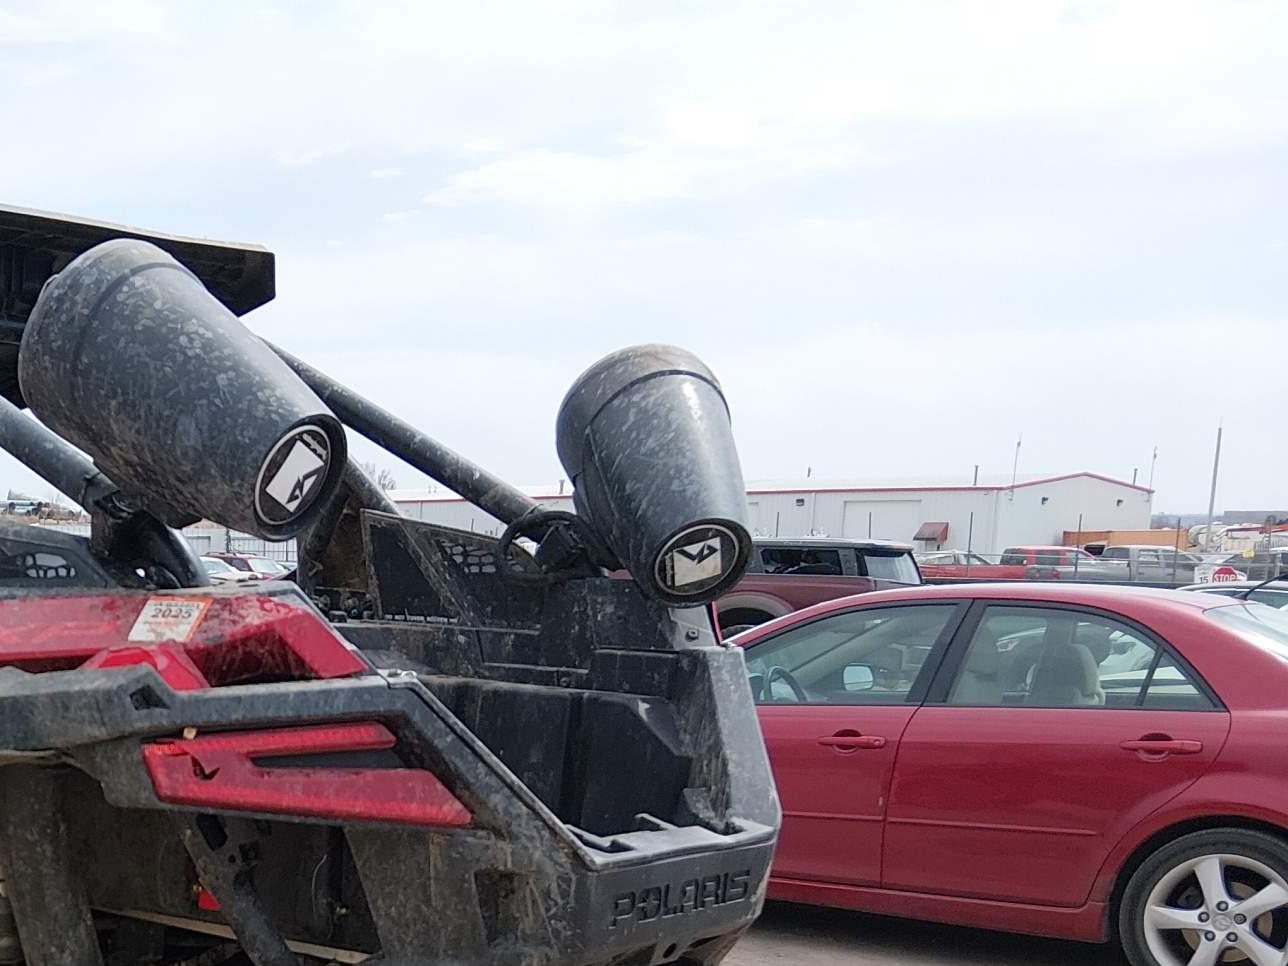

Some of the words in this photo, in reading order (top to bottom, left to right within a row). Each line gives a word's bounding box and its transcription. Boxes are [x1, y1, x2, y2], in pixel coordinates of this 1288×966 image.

[1214, 573, 1236, 584] STOP
[151, 607, 194, 619] 2025
[608, 868, 751, 929] POLARIS
